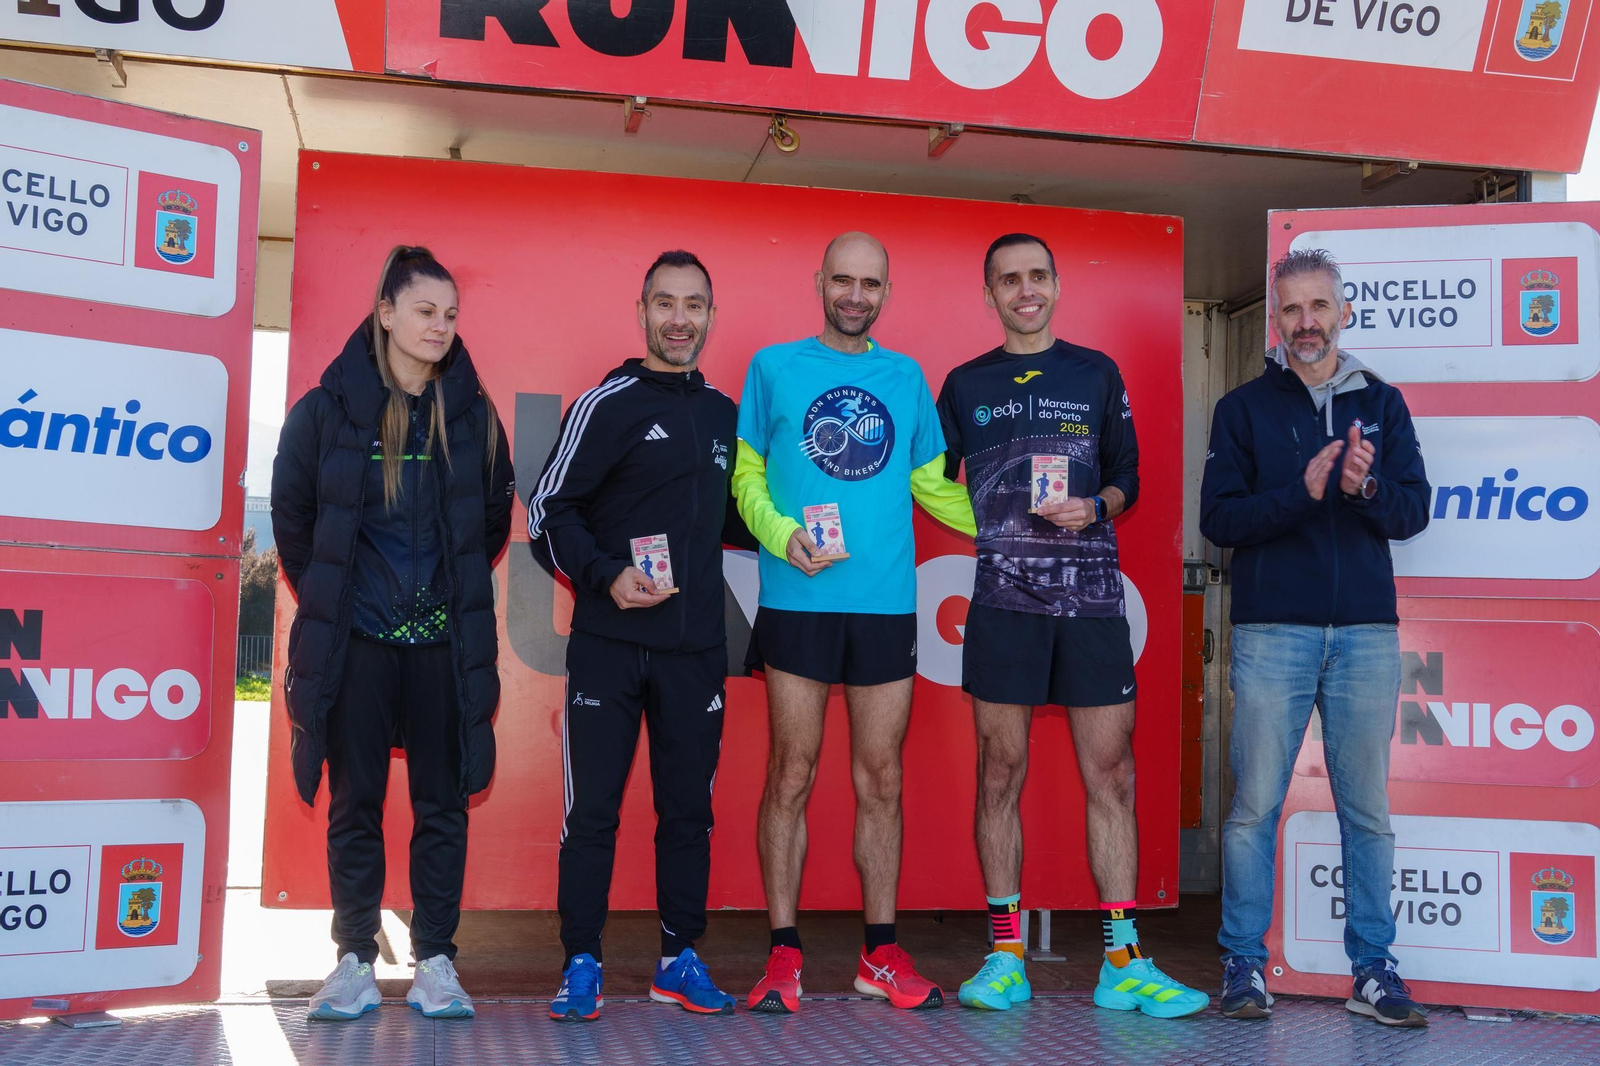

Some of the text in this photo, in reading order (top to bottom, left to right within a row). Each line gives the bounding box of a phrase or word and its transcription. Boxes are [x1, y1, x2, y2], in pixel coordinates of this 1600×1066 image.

[1285, 0, 1441, 36] DE VIGO
[2, 169, 110, 208] CELLO
[6, 200, 88, 236] VIGO
[1343, 278, 1477, 302] ONCELLO
[1386, 306, 1458, 328] VIGO
[808, 389, 877, 420] ADN RUNNERS
[992, 399, 1023, 419] edp
[1038, 398, 1090, 412] Maratona
[1038, 409, 1081, 422] do Porto
[0, 388, 212, 463] ántico
[1059, 422, 1090, 435] 2025
[822, 457, 880, 476] AND BIKERS
[1430, 468, 1589, 521] ntico
[0, 869, 71, 896] LLO
[1310, 864, 1482, 896] COELLO
